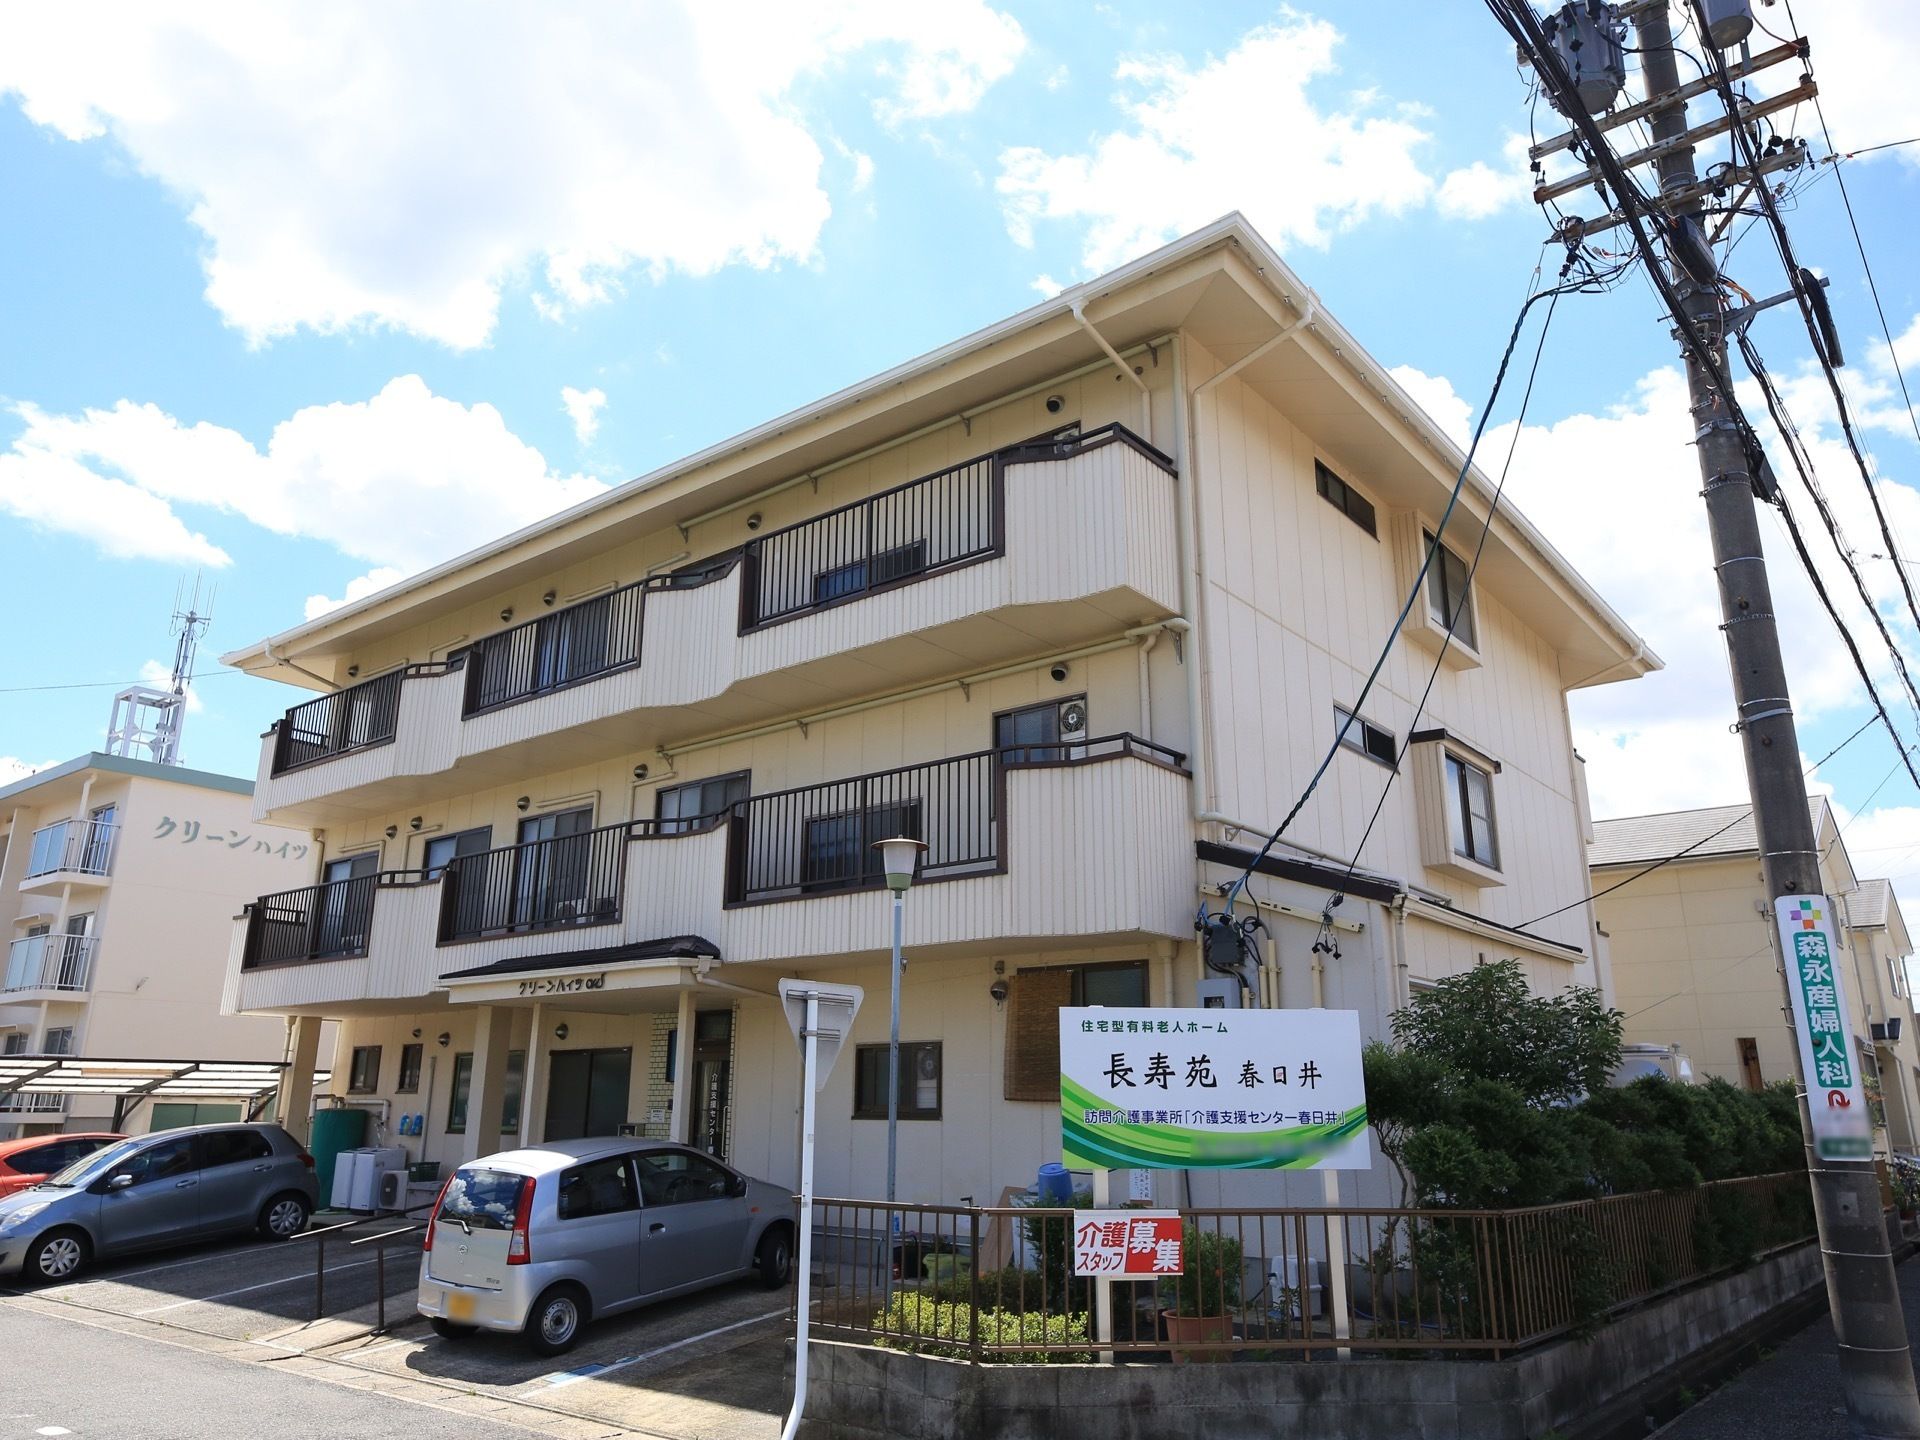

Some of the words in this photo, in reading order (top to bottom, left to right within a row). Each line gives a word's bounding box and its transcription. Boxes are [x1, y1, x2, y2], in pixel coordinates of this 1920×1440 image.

[153, 816, 308, 860] クリーンハイツ
[519, 978, 584, 995] クリーンハイツ
[1797, 936, 1849, 1084] 森永産婦人科
[1081, 1020, 1228, 1033] 住宅型有料老人ホーム
[1103, 1052, 1218, 1090] 長寿苑
[1237, 1059, 1322, 1089] 春日井
[1084, 1109, 1346, 1126] 訪問介護事業所「介護支援センター春日井」
[1077, 1221, 1128, 1248] 介護
[1129, 1221, 1181, 1272] 募集
[1076, 1251, 1124, 1272] スタッフ
